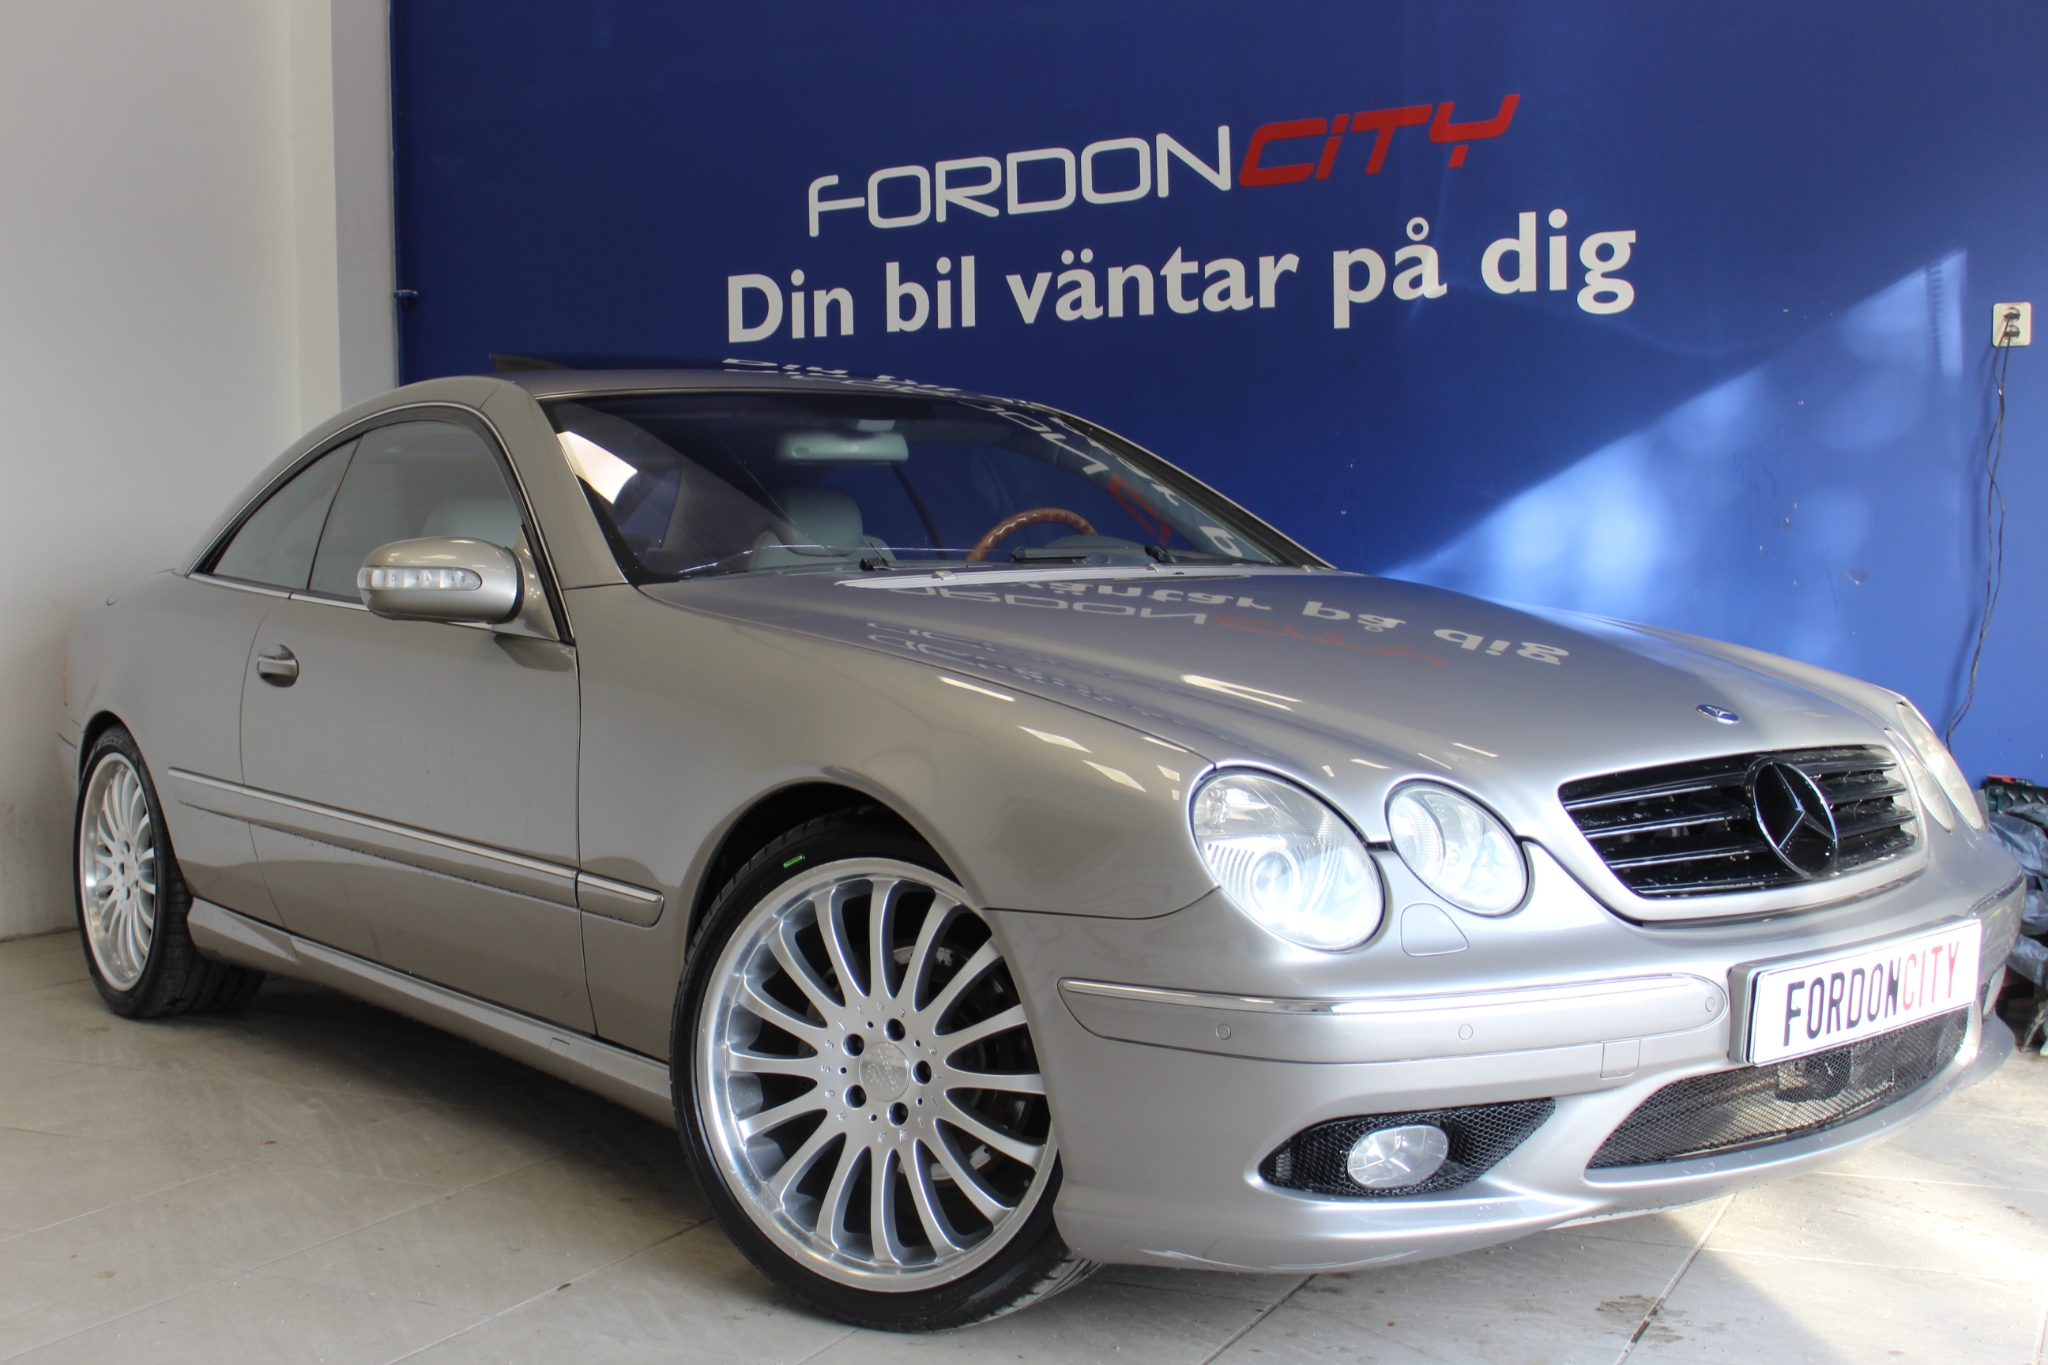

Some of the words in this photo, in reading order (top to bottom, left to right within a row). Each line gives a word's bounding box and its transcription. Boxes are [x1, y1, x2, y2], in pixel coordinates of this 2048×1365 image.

[727, 268, 855, 343] Din
[885, 255, 976, 333] bil
[1005, 247, 1300, 325] väntar
[1332, 216, 1448, 329] på
[1480, 208, 1637, 315] dig
